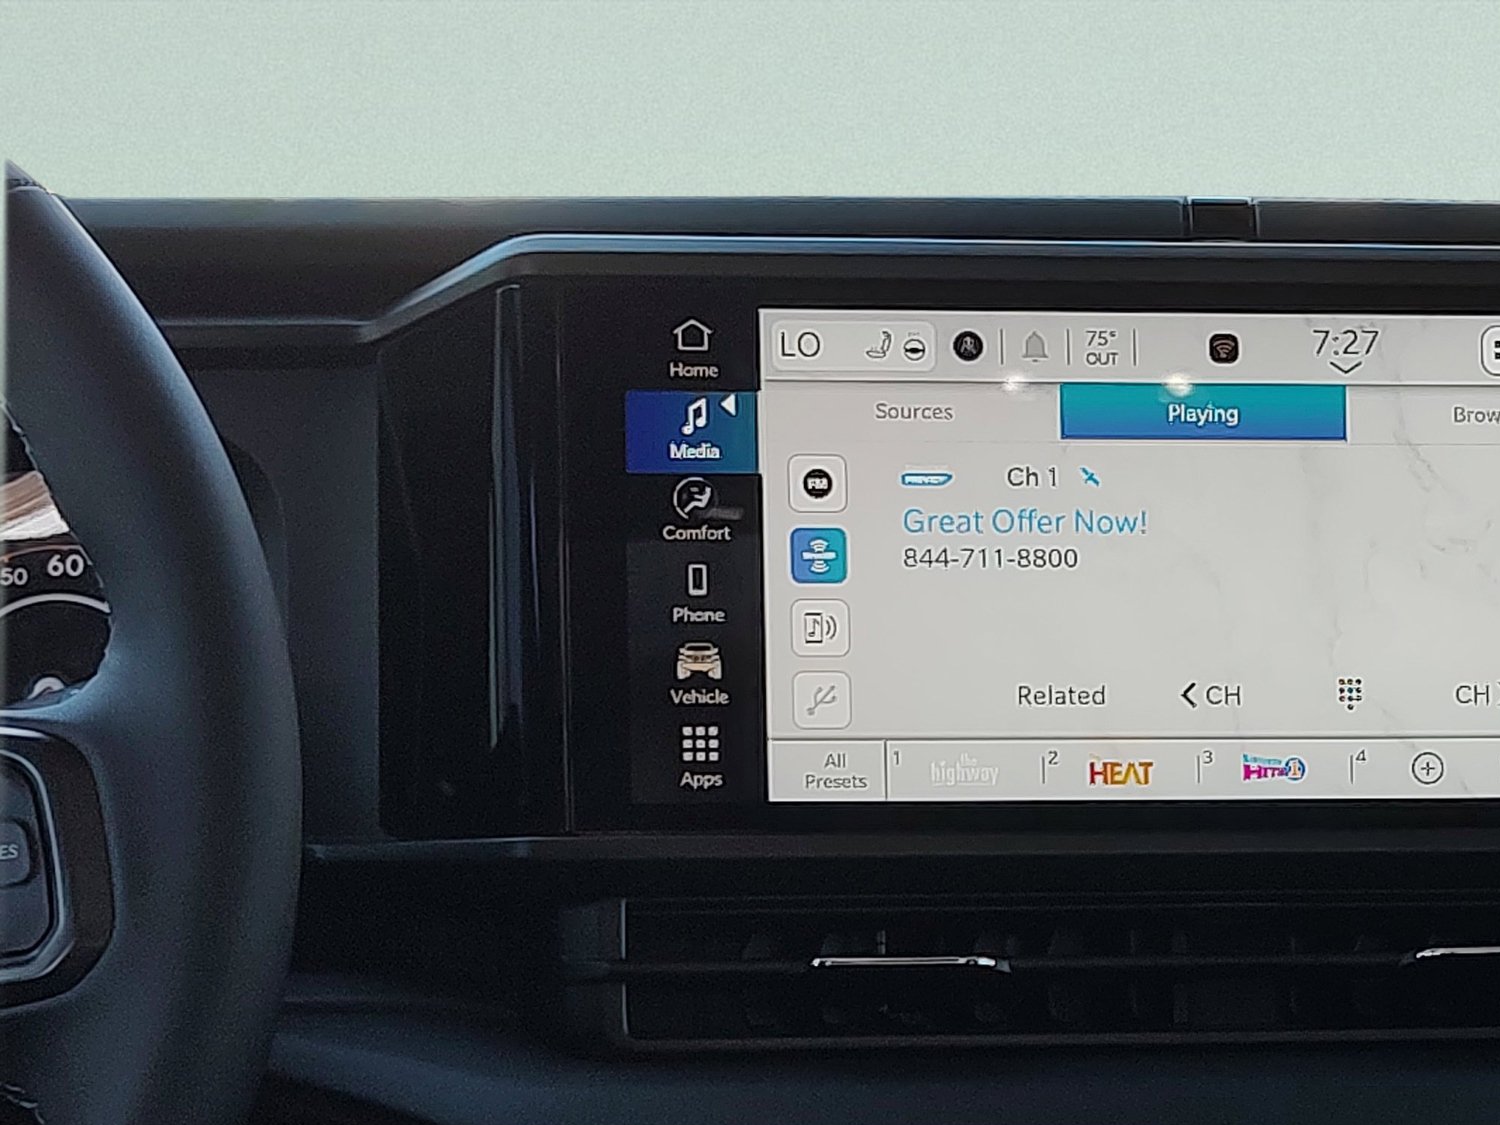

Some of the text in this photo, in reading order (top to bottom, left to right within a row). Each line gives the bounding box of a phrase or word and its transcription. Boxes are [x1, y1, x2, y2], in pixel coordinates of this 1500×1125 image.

[780, 332, 821, 358] LO
[1313, 329, 1379, 356] 7:27
[1085, 353, 1119, 366] OUT
[669, 362, 719, 378] Home
[875, 403, 953, 420] Sources
[1167, 402, 1239, 426] Playing
[669, 442, 721, 460] Media
[1007, 467, 1058, 487] Ch 1
[903, 509, 1147, 535] Great Offer Now!
[662, 525, 731, 541] Comfort
[903, 549, 1078, 569] 844-711-8800
[0, 554, 85, 586] 50 60
[672, 607, 726, 624] Phone
[670, 688, 729, 705] Vehicle
[1018, 684, 1106, 706] Related
[1206, 685, 1241, 706] CH
[1456, 685, 1490, 706] CH
[825, 753, 846, 768] All
[893, 751, 901, 765] 1
[1048, 751, 1058, 765] 2
[1203, 750, 1214, 764] 3
[1355, 750, 1367, 762] 4
[680, 773, 723, 791] Apps
[805, 774, 868, 789] Presets
[930, 761, 999, 786] highway
[1089, 761, 1154, 785] HEAT
